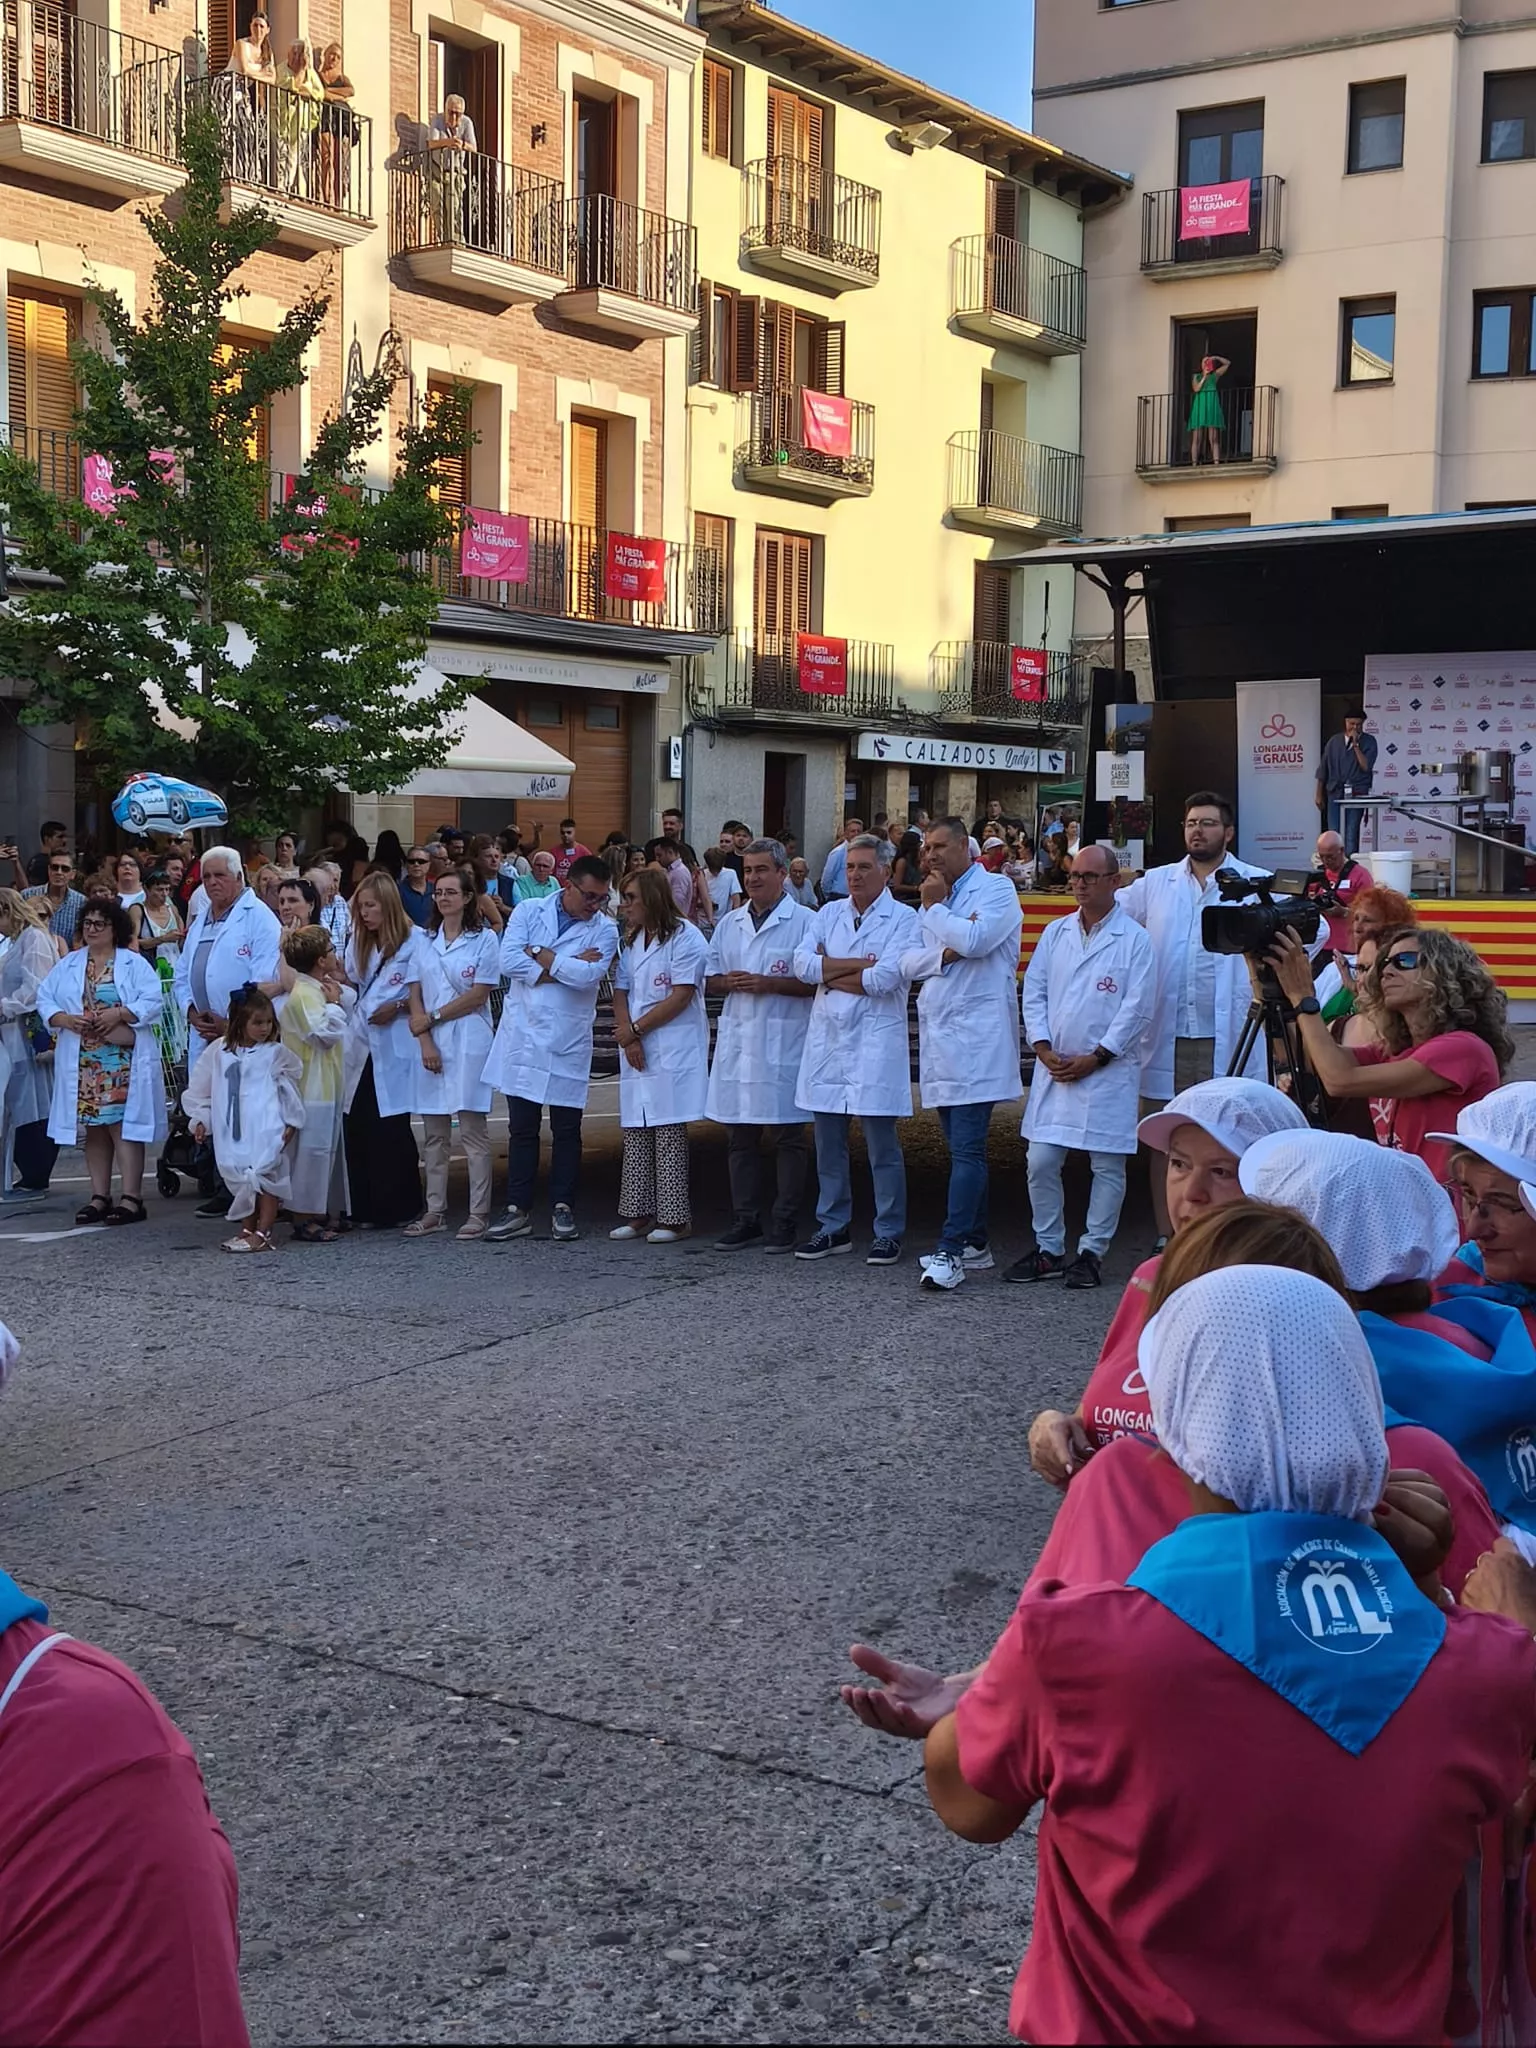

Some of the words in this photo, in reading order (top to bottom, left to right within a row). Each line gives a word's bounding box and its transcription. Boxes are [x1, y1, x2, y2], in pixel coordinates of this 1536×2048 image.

[1200, 193, 1223, 203] FIESTA
[481, 522, 505, 536] FIESTA
[426, 654, 462, 666] ADICIÓN
[1253, 744, 1304, 754] LONGANIZA
[905, 741, 996, 765] CALZADOS
[1005, 748, 1036, 770] Lady's
[1263, 752, 1304, 764] GRAUS
[1111, 770, 1130, 780] SABOR
[526, 776, 557, 797] Melsa
[1094, 1406, 1154, 1432] LONGAN
